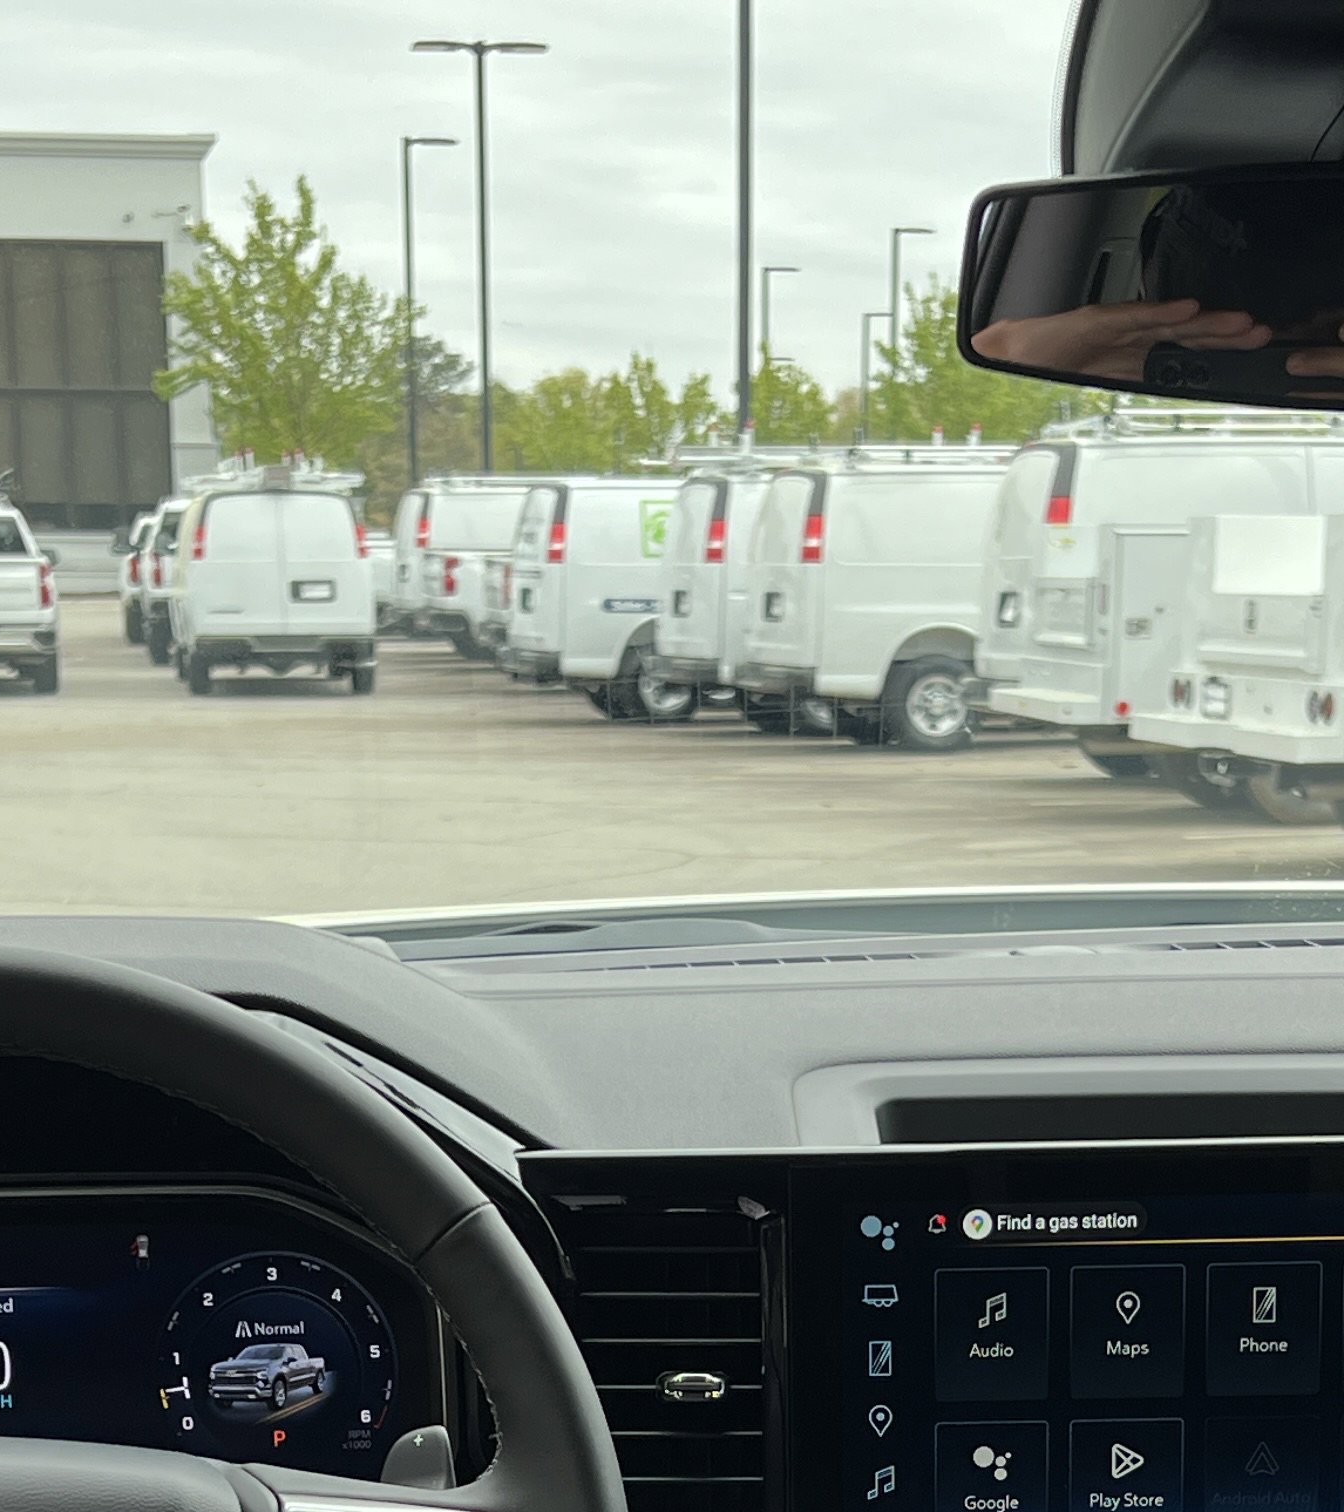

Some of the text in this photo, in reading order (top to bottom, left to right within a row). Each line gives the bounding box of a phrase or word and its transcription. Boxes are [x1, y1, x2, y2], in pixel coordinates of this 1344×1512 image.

[997, 1212, 1138, 1234] Find a gas station
[266, 1267, 278, 1281] 3
[203, 1292, 214, 1307] 2
[331, 1288, 342, 1302] 4
[254, 1321, 305, 1335] Normal
[370, 1345, 381, 1359] 5
[969, 1343, 1014, 1358] Audio
[1106, 1340, 1150, 1358] Maps
[1239, 1337, 1289, 1353] Phone
[172, 1352, 181, 1365] 1
[182, 1417, 194, 1430] 0
[360, 1410, 371, 1423] 6
[273, 1429, 286, 1447] P
[1089, 1492, 1164, 1511] Play Store
